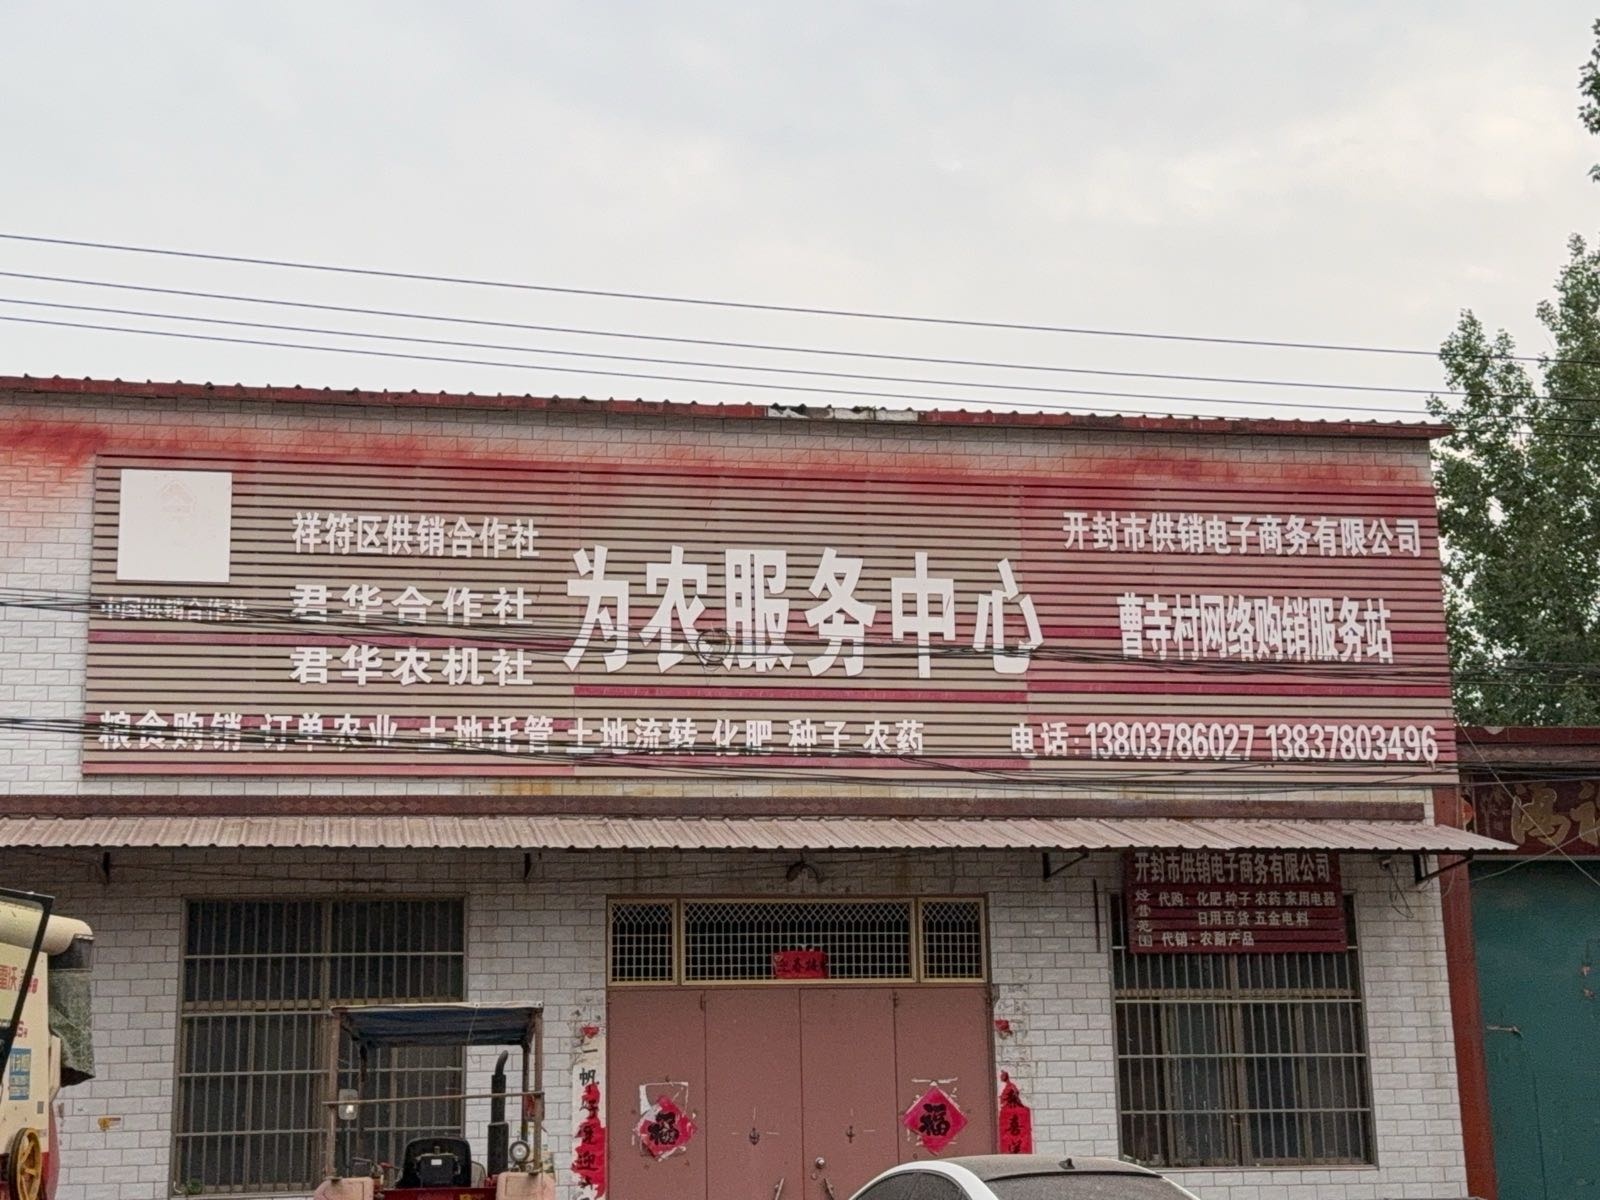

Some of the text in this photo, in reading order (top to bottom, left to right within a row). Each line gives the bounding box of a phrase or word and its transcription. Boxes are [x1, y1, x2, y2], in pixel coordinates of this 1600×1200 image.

[292, 511, 540, 558] 祥符区供销合作社
[1062, 511, 1421, 557] 开封市供销电子商务有限公司
[290, 583, 533, 626] 君华合作社
[563, 544, 1044, 678] 为农服务中心
[1117, 592, 1393, 664] 曹寺村网络购销服务站
[290, 644, 533, 687] 君华农机社
[98, 709, 924, 756] 粮食购销 订单农业 土地托管 土地流转 化肥 种子 农药
[1266, 724, 1438, 762] 13837803496
[1135, 852, 1330, 883] 开封市供销电子商务有限公司
[918, 1103, 950, 1136] 福
